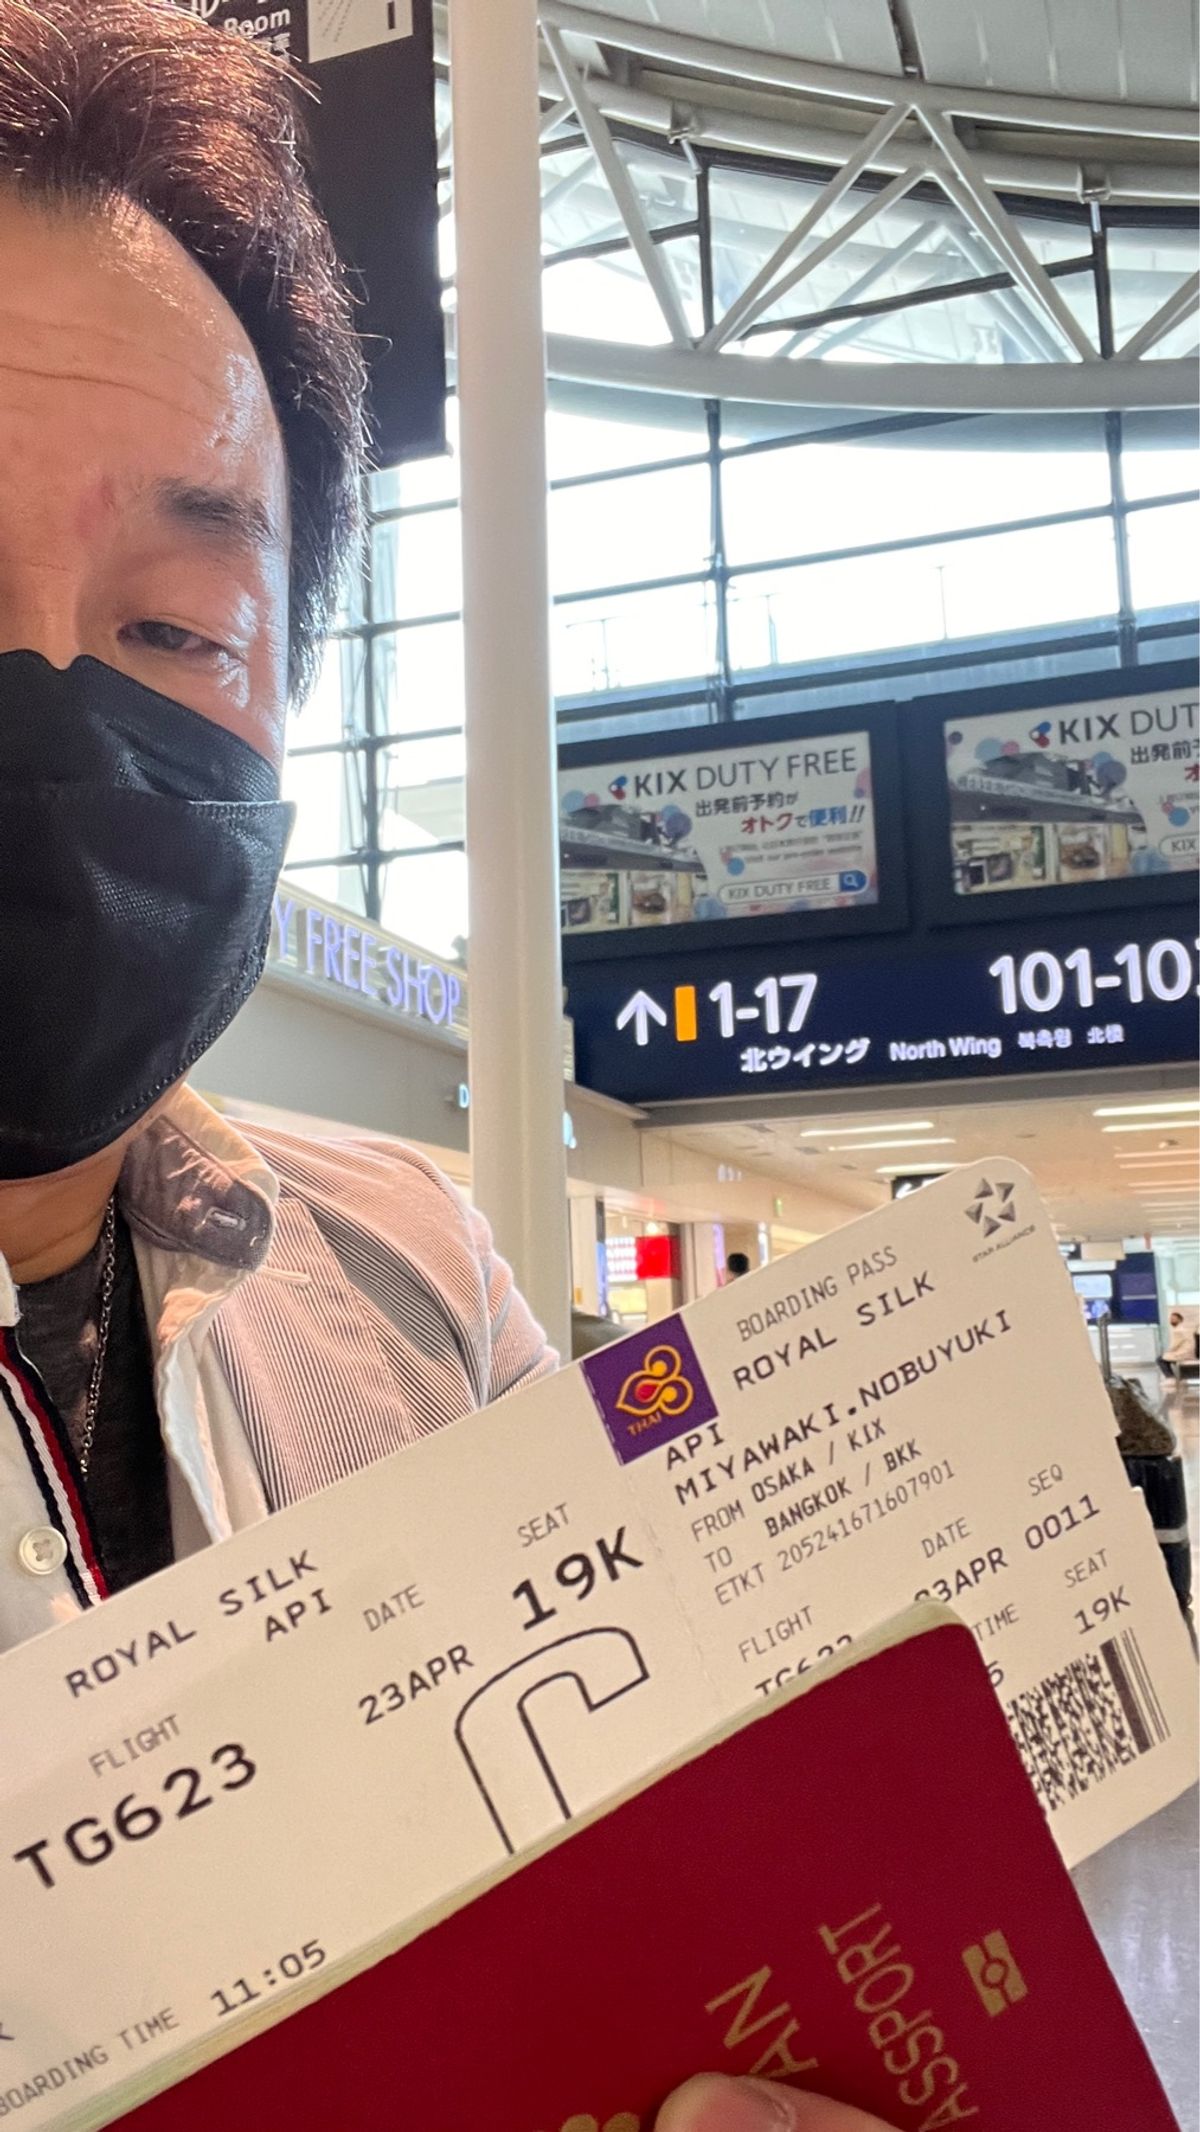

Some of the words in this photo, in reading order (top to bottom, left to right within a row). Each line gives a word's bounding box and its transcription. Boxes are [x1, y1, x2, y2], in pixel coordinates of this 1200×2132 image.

[223, 9, 290, 37] Room
[1059, 713, 1120, 744] KIX
[1130, 702, 1198, 736] DUT
[635, 769, 688, 798] KIX
[696, 756, 780, 791] DUTY
[787, 747, 858, 779] FREE
[695, 791, 799, 818] 出発前予約が
[1171, 838, 1197, 852] KIX
[727, 885, 751, 900] KIX
[754, 880, 795, 898] DUTY
[797, 878, 831, 894] FREE
[306, 906, 378, 997] FREE
[385, 944, 461, 1026] SHOP
[988, 937, 1198, 1015] 101-10
[709, 972, 818, 1038] 1-17
[740, 1037, 870, 1073] 北ウイング
[889, 1040, 947, 1062] North
[948, 1035, 1002, 1059] Wing
[972, 1246, 995, 1264] STAR
[996, 1224, 1037, 1252] ALLIANCE
[735, 1275, 839, 1343] BOARDING
[847, 1245, 898, 1286] PASS
[732, 1327, 838, 1391] ROYAL
[856, 1270, 936, 1327] SILK
[626, 1409, 662, 1437] THAI
[674, 1309, 1013, 1506] MIYAWAKI.NOBUYUKI
[666, 1421, 726, 1471] API
[691, 1498, 746, 1543] FROM
[751, 1456, 816, 1504] OSAKA
[847, 1416, 887, 1452] KIX
[703, 1545, 734, 1575] TO
[763, 1476, 853, 1539] BANGKOK
[883, 1438, 923, 1473] BKK
[1027, 1463, 1065, 1498] SEQ
[516, 1501, 572, 1549] SEAT
[714, 1562, 767, 1607] ETKT
[777, 1459, 956, 1572] 205241671607901
[920, 1516, 972, 1559] DATE
[1023, 1493, 1101, 1551] 0011
[512, 1525, 645, 1632] 19K
[1064, 1547, 1111, 1589] SEAT
[65, 1619, 198, 1699] ROYAL
[218, 1549, 319, 1617] SILK
[264, 1587, 333, 1643] API
[363, 1583, 426, 1633] DATE
[738, 1605, 816, 1664] FLIGHT
[1073, 1584, 1132, 1636] 19K
[358, 1643, 475, 1727] 23APR
[88, 1713, 182, 1779] FLIGHT
[13, 1742, 258, 1890] TG623
[115, 2006, 181, 2052] TIME
[209, 1938, 328, 2017] 11:05
[817, 1901, 981, 2132] ASSPORT
